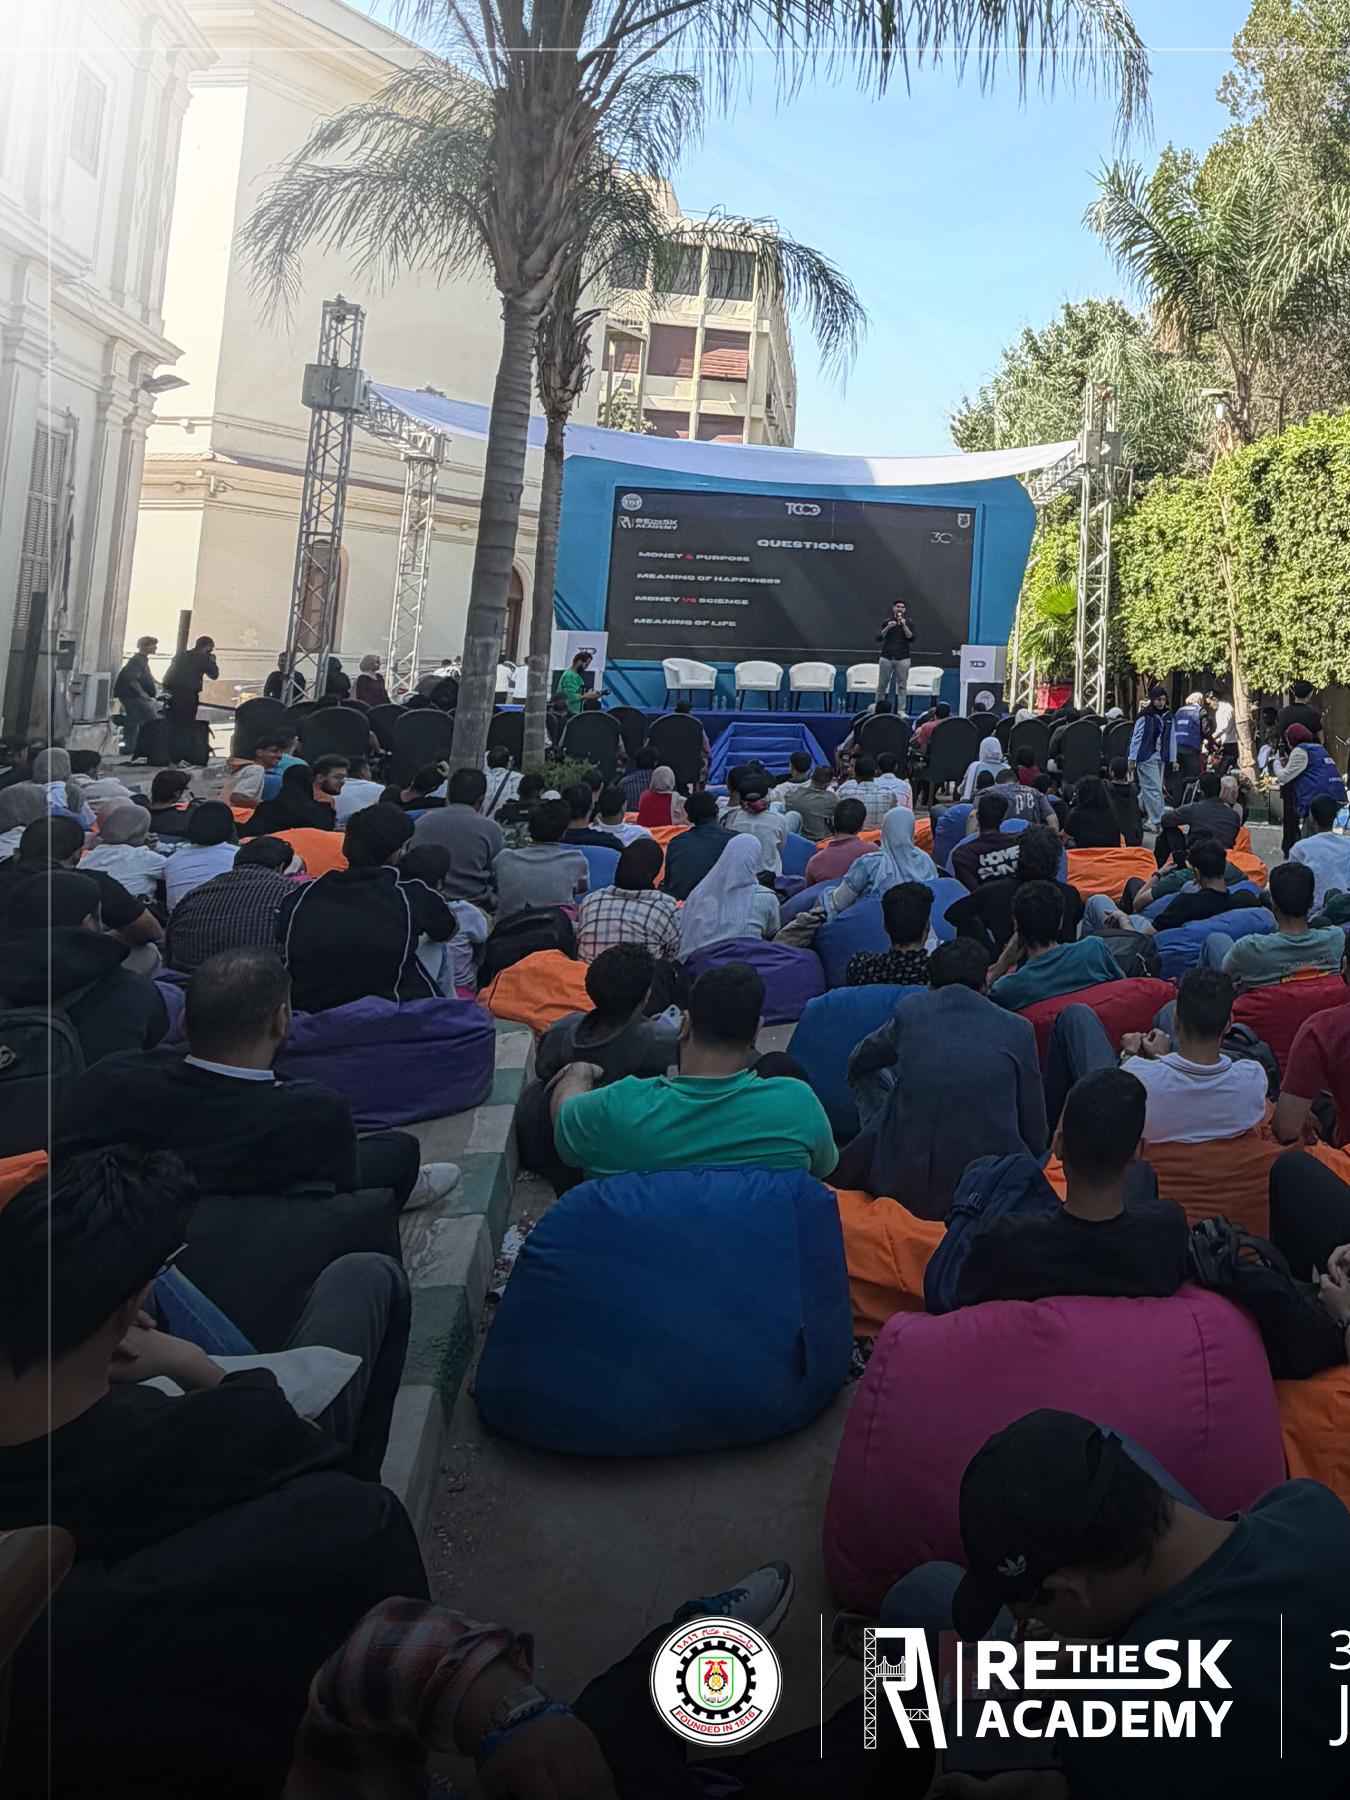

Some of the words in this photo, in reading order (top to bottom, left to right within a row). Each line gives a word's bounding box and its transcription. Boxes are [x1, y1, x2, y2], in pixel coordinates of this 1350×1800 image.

[757, 539, 855, 551] QUESTIONS
[638, 551, 684, 559] MONEY
[695, 554, 750, 562] PURPOSE
[636, 573, 696, 581] MEANING
[714, 576, 781, 584] HAPPINESS
[634, 595, 680, 603] MONEY
[698, 597, 749, 605] SCIENCE
[633, 618, 693, 626] MEANING
